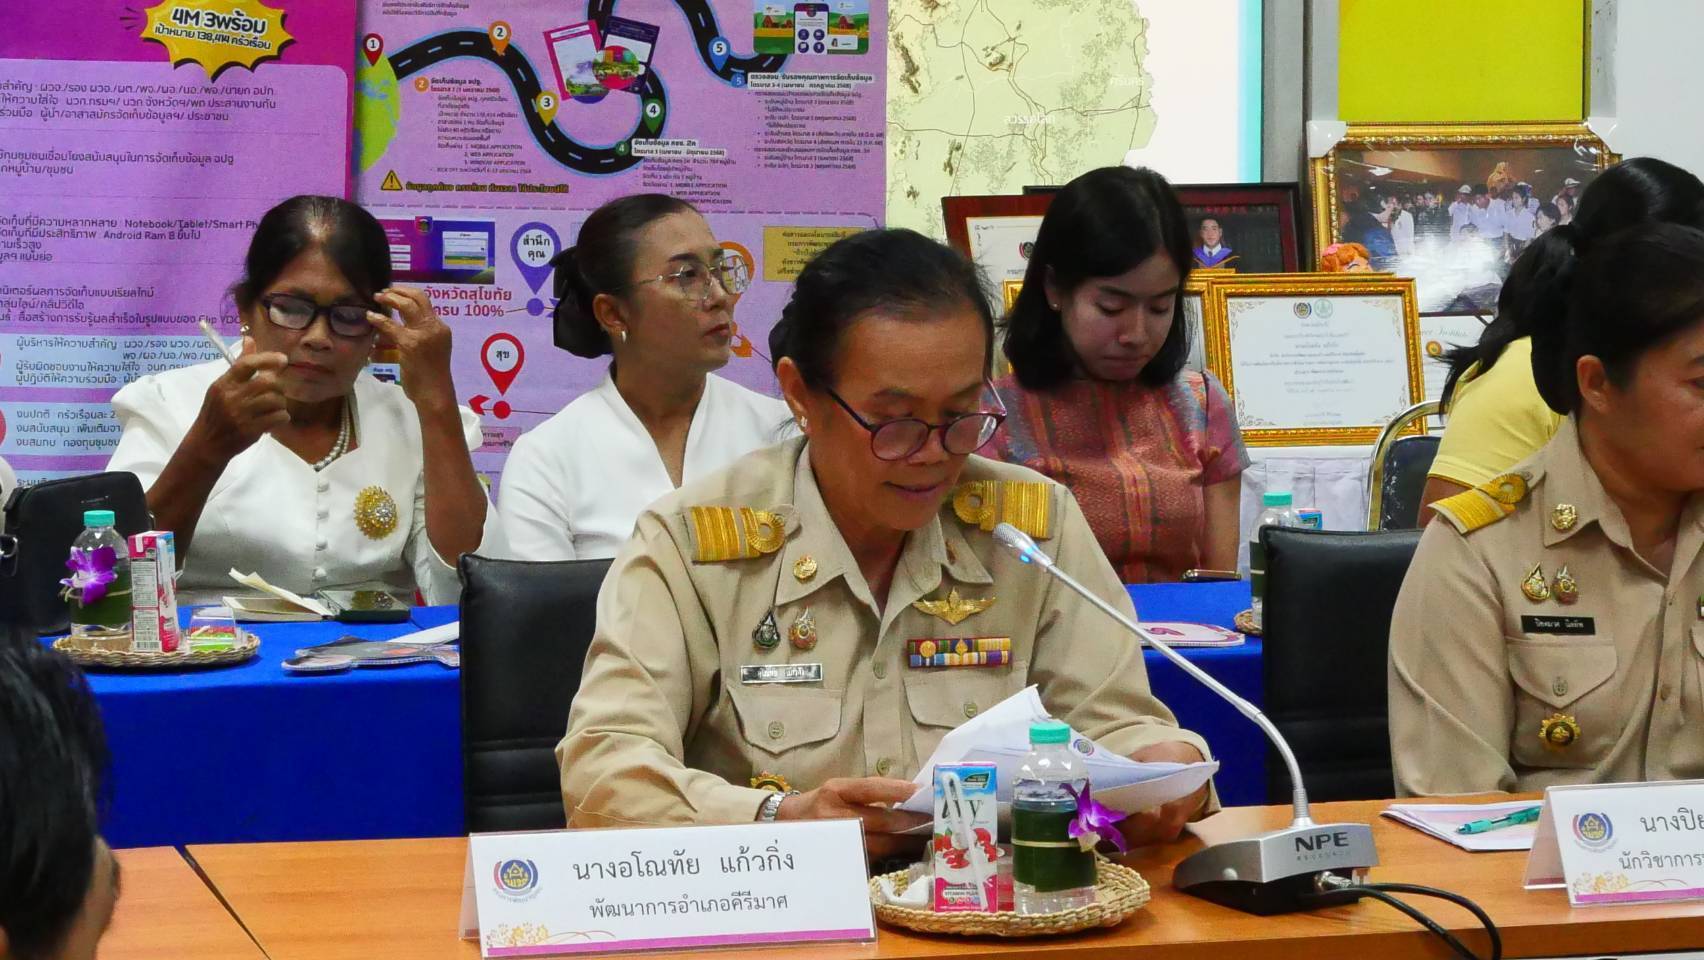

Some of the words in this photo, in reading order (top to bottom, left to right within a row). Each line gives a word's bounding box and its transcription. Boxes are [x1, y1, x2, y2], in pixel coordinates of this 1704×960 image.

[173, 8, 199, 25] 4M
[204, 10, 265, 33] 3พร้อม
[497, 28, 504, 37] 2
[370, 40, 376, 48] 1
[716, 43, 723, 52] 5
[0, 80, 33, 93] สำคัญ
[544, 98, 551, 107] 3
[650, 104, 656, 115] 4
[104, 230, 141, 240] Android
[145, 231, 166, 240] Ram
[522, 234, 550, 247] สำนึก
[528, 249, 546, 261] คุณ
[464, 304, 505, 317] 100%
[77, 423, 121, 433] เพิ่มเติมจา
[1295, 831, 1350, 852] NPE
[573, 849, 700, 881] นางอโณทัย
[720, 840, 795, 873] แก้วกิ่ง
[1619, 850, 1704, 870] นักวิชาการ
[589, 891, 789, 920] พัฒนาการอำเภอคีรีมาศ
